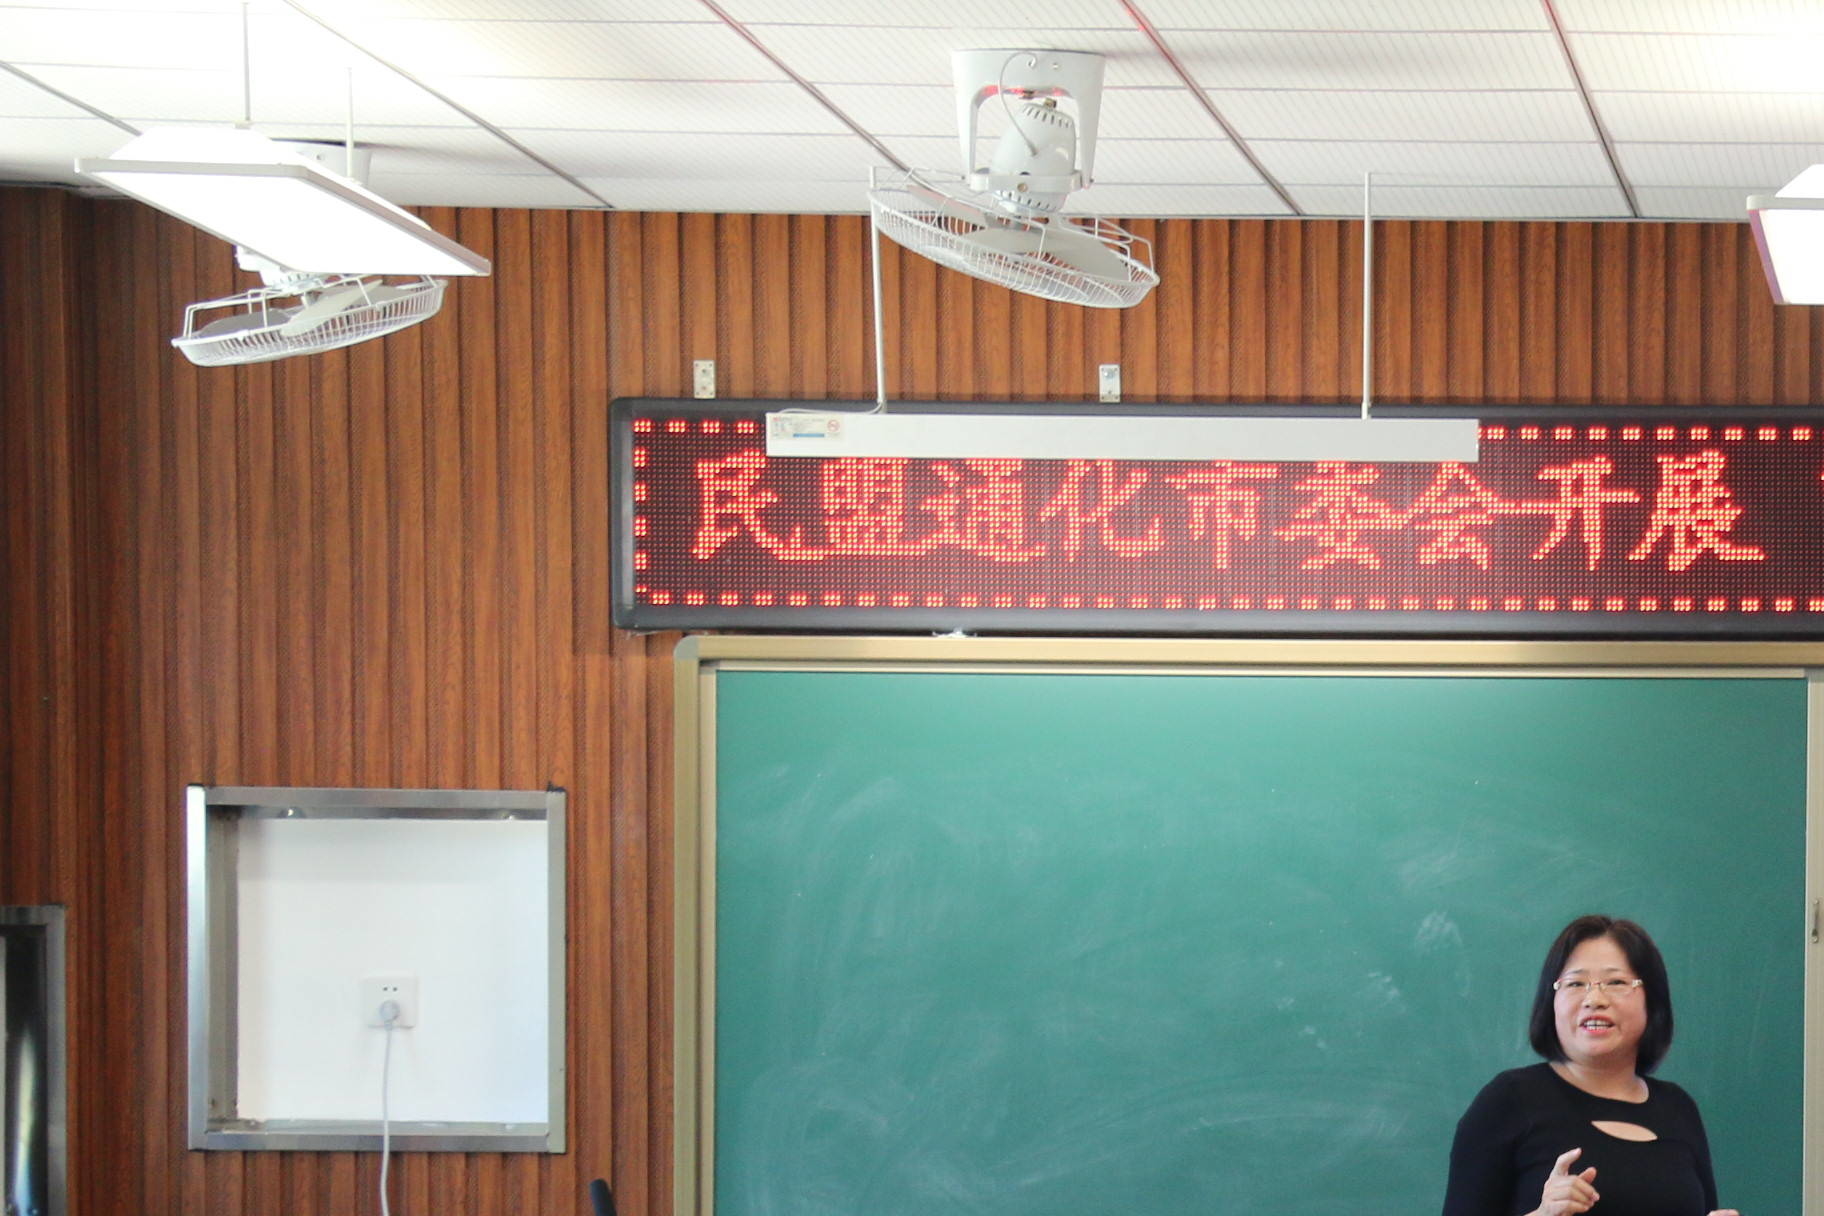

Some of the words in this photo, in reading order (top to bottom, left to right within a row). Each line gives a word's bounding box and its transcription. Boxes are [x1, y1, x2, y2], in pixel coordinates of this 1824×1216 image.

[692, 448, 1767, 573] 民盟通化市委会开展
